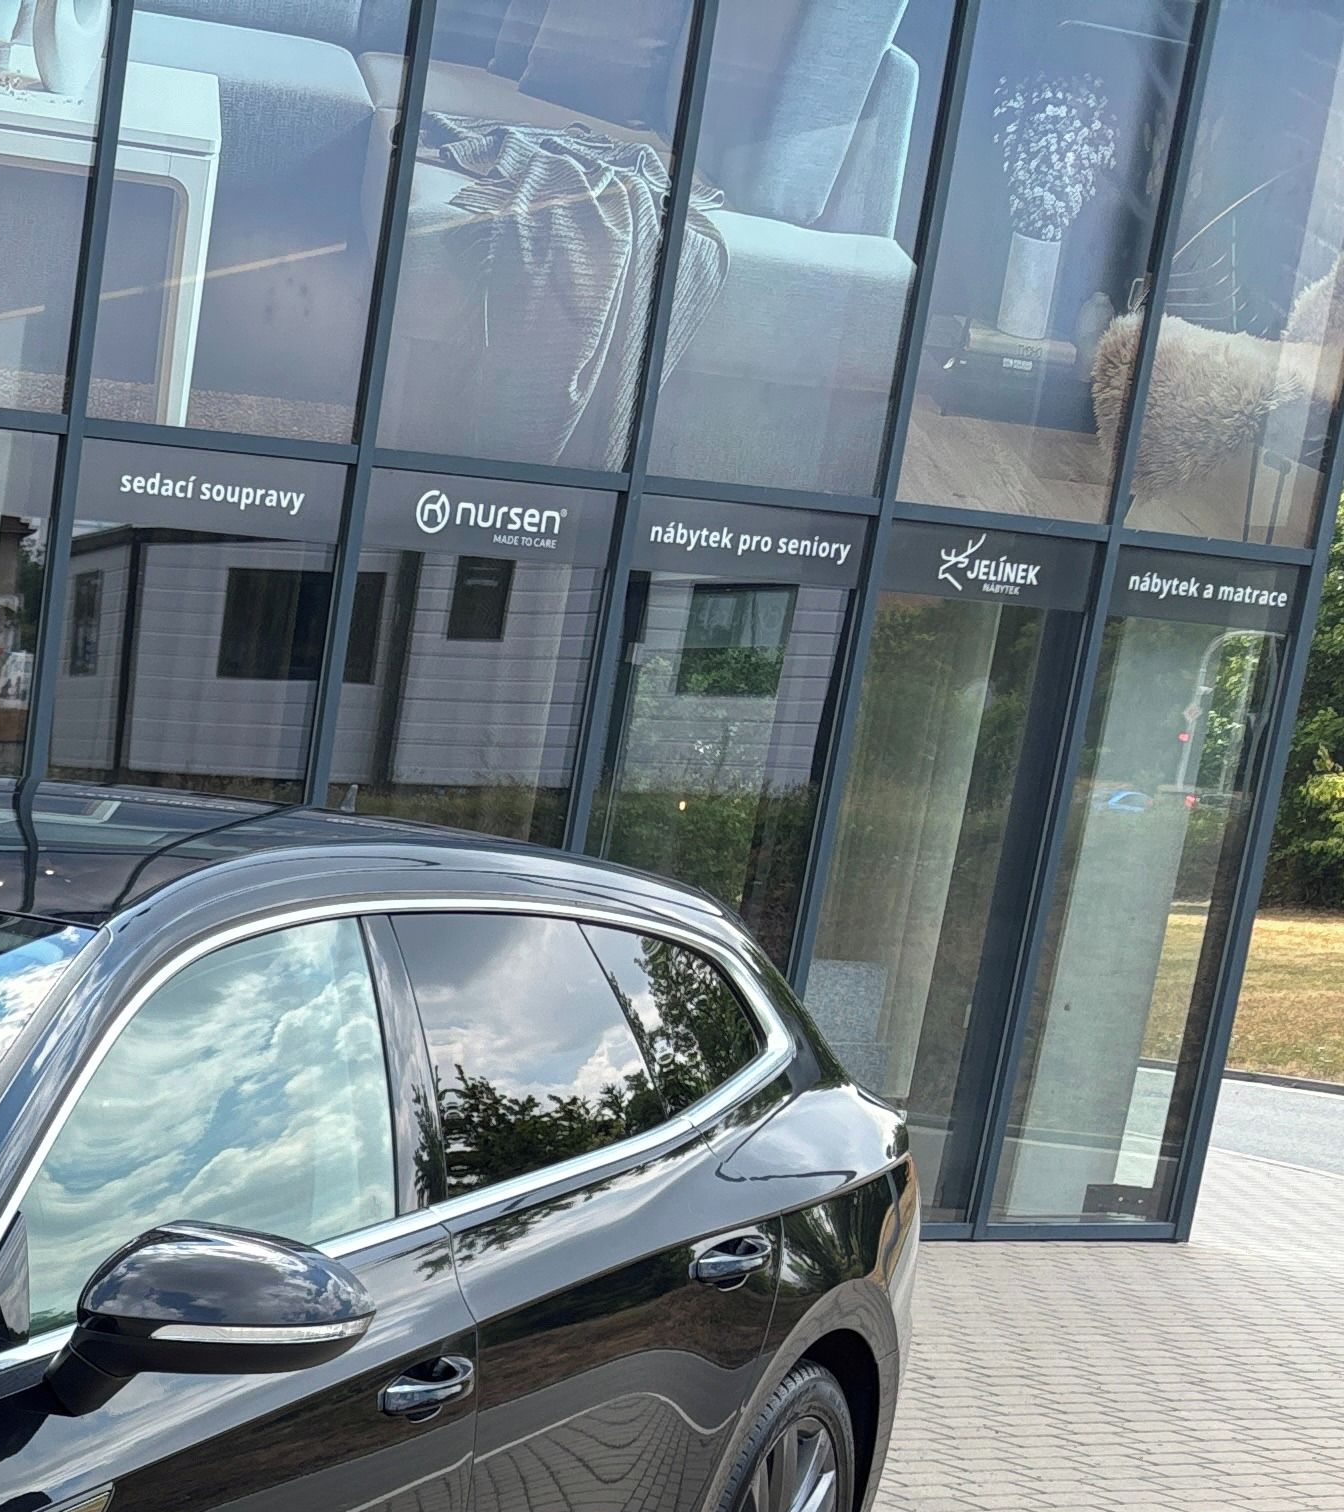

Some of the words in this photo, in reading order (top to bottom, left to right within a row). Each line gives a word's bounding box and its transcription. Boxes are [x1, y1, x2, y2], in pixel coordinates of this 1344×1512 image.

[120, 471, 195, 499] sedací
[199, 482, 305, 515] soupravy
[455, 500, 561, 535] nursen
[492, 534, 519, 546] MADE
[519, 537, 530, 547] TO
[531, 538, 557, 550] CARE
[649, 520, 732, 549] nábytek
[737, 532, 773, 556] pro
[777, 535, 852, 565] seniory
[967, 554, 1041, 586] JELÍNEK
[1128, 570, 1198, 600] nábytek
[1203, 582, 1215, 600] a
[1217, 584, 1289, 608] matrace
